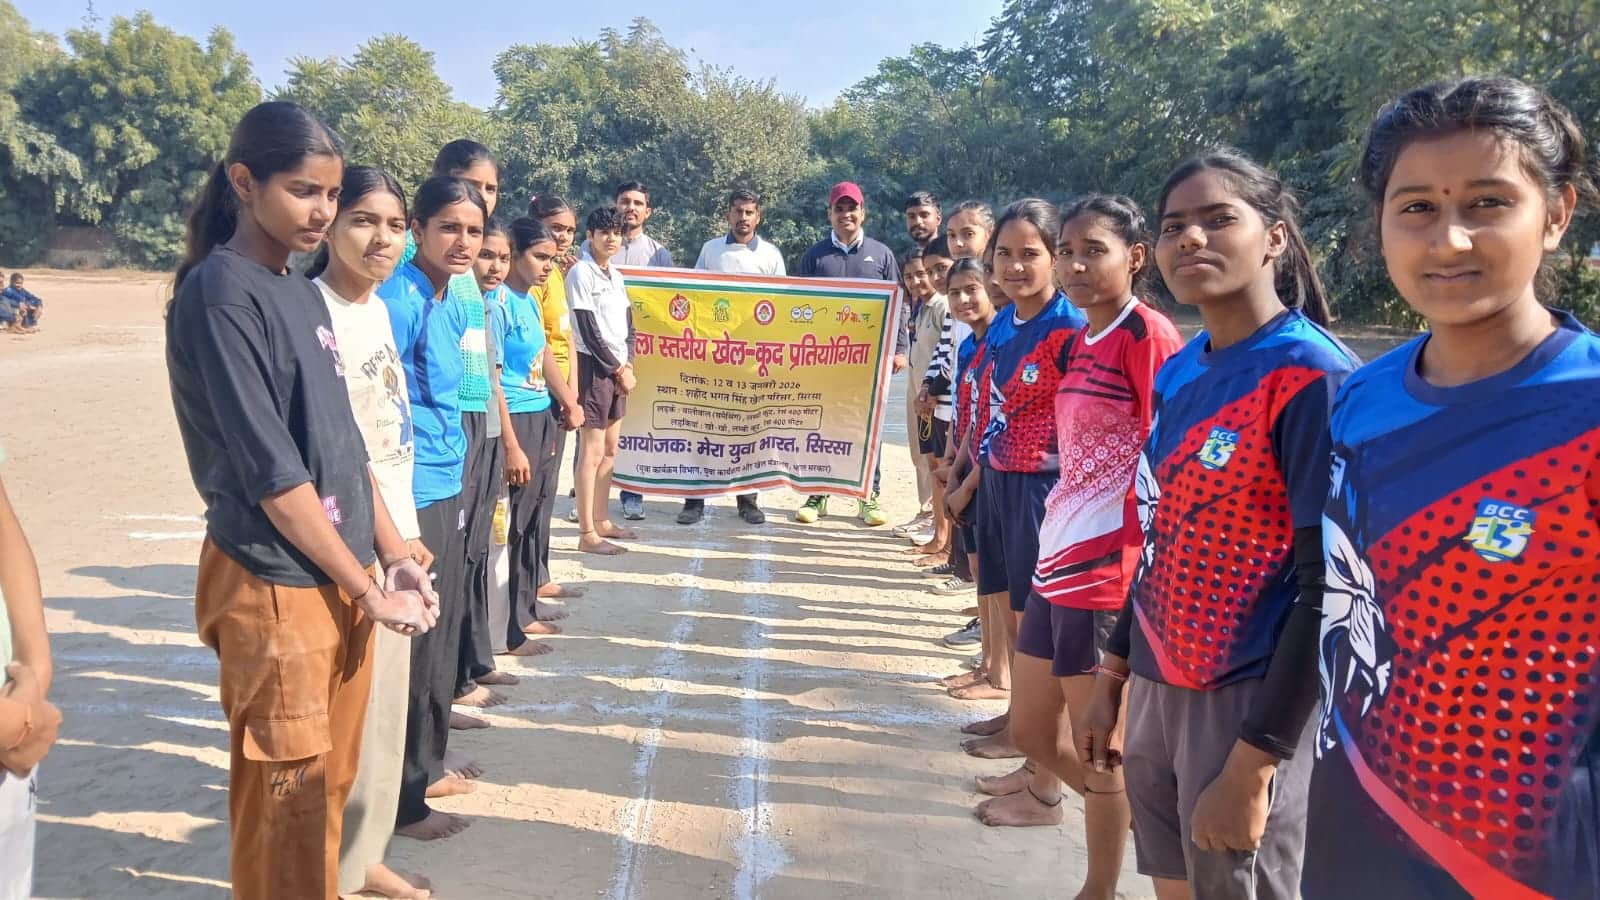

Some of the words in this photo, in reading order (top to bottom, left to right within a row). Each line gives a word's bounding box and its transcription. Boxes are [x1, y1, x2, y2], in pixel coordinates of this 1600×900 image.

[635, 332, 654, 355] ला
[659, 327, 707, 361] स्तरीय
[712, 331, 785, 377] खेल-कूद
[789, 334, 871, 370] प्रतियोगिता
[713, 378, 724, 387] 12
[737, 381, 747, 389] 13
[779, 381, 801, 389] 2026
[1210, 430, 1237, 442] BCC
[618, 432, 692, 453] आयोजक:
[697, 437, 725, 458] मेरा
[729, 441, 756, 464] युवा
[760, 436, 800, 453] भारत,
[806, 432, 853, 456] सिरसा
[1483, 504, 1529, 520] BCC
